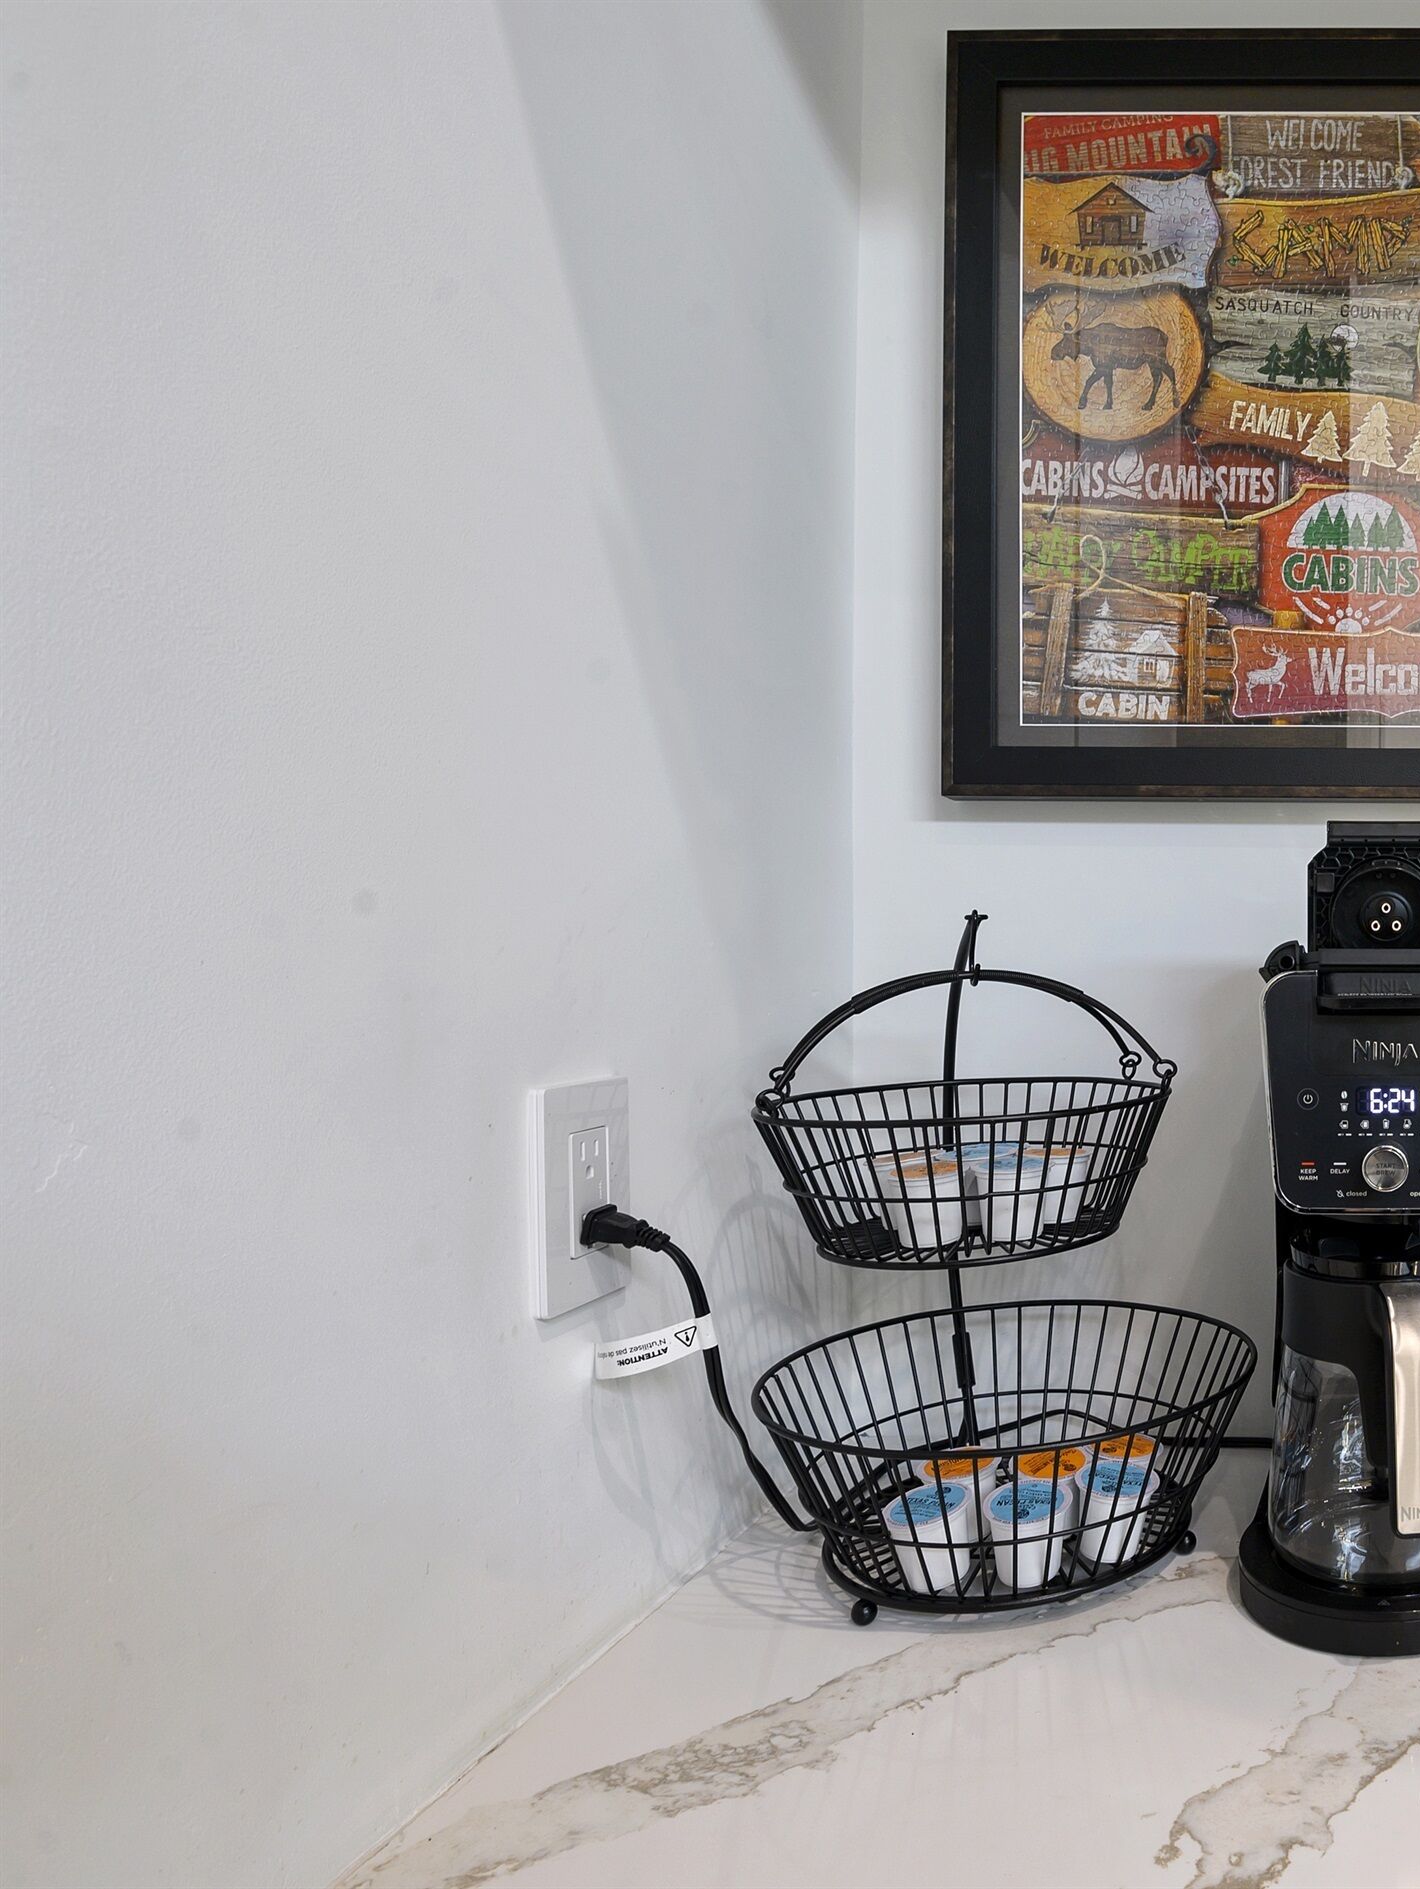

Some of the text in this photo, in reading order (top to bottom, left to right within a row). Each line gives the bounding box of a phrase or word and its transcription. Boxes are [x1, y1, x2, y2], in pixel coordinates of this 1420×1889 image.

[1043, 122, 1098, 140] FAMILY
[1265, 118, 1366, 152] WELCOME
[1318, 159, 1398, 189] FRIEND
[1232, 210, 1410, 279] CAMP
[1040, 242, 1186, 280] WELCOME
[1214, 296, 1415, 322] SASQUATCH COUNTRY
[1229, 400, 1313, 442] FAMILY
[1022, 459, 1276, 504] CABINS CAMPSITES
[1281, 551, 1420, 598] CABINS
[1077, 690, 1170, 721] CABIN
[1352, 1038, 1419, 1067] NINJA
[1369, 1088, 1416, 1114] 6:24
[1345, 1190, 1368, 1198] closed
[614, 1347, 628, 1357] pas
[616, 1346, 669, 1367] ATTENTION:
[628, 1337, 667, 1354] N'utilisez
